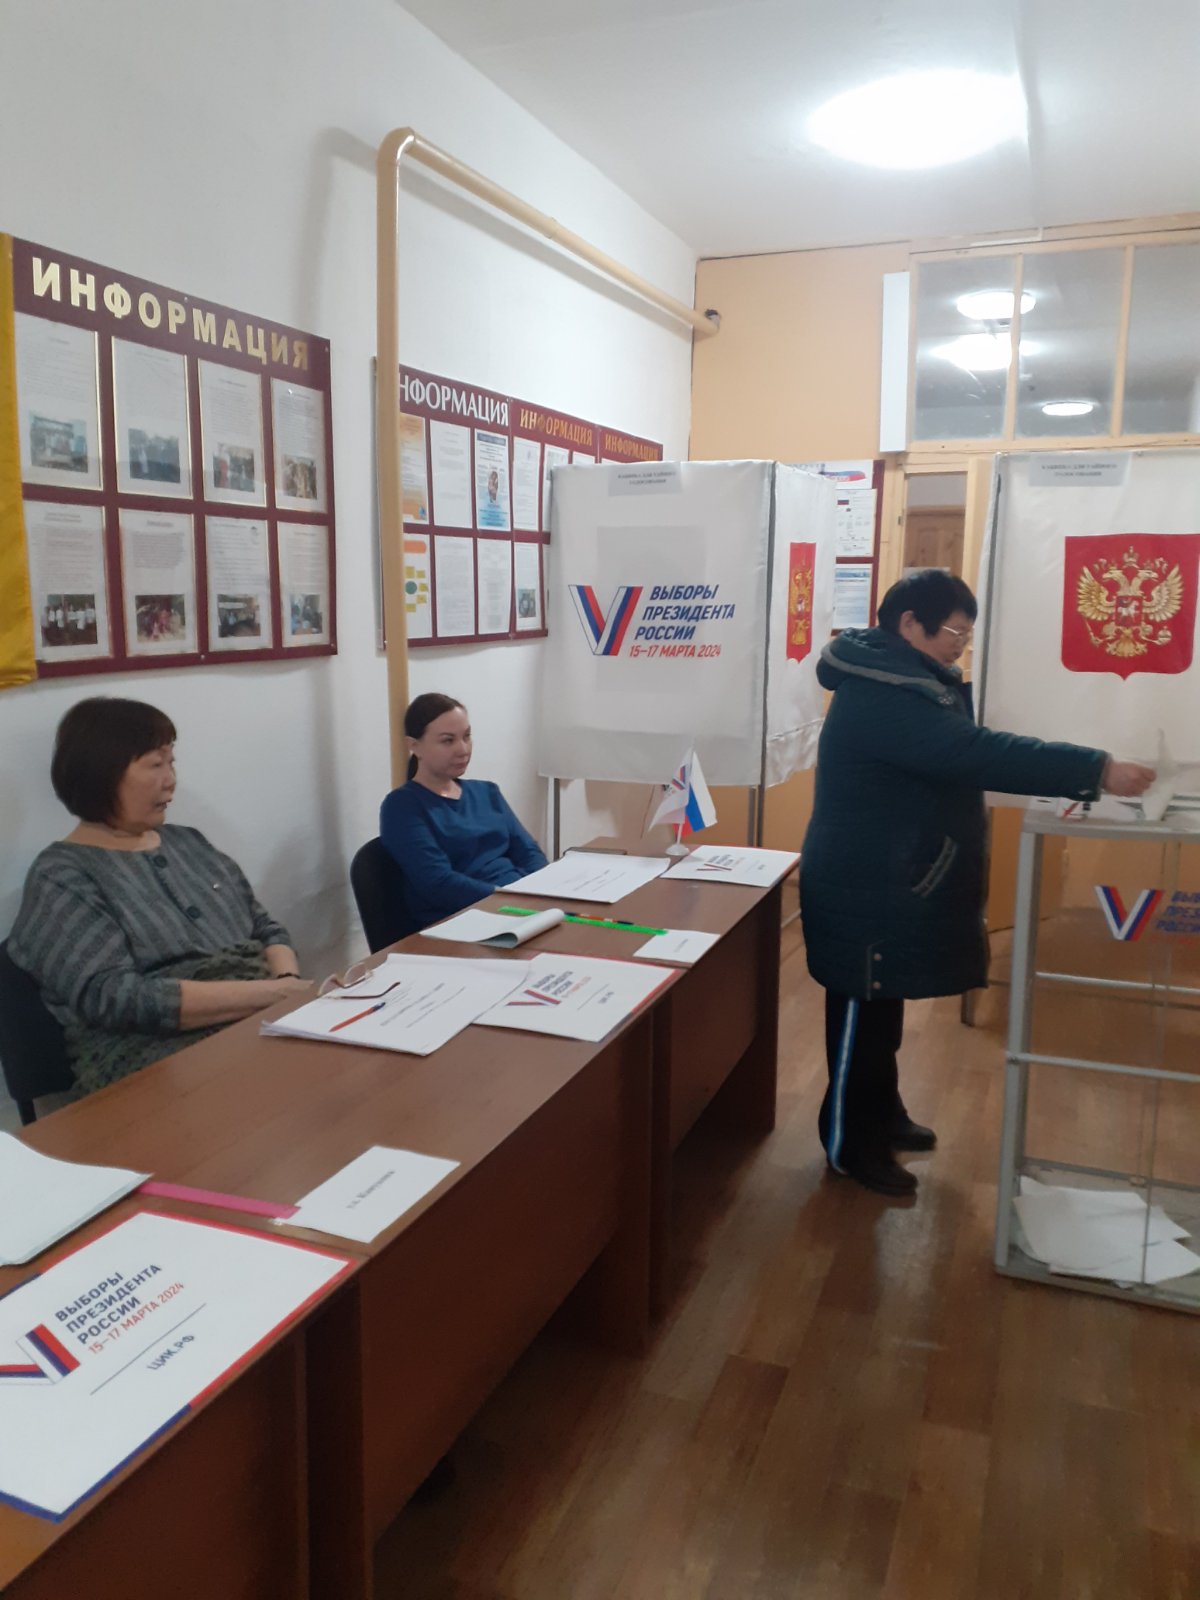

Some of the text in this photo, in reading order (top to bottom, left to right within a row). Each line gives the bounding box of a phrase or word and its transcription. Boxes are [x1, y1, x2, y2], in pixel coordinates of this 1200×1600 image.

[31, 257, 309, 371] ИНФОРМАЦИЯ
[399, 374, 509, 427] НФОРМАЦИЯ
[520, 408, 593, 446] ИНФОРМАЦИЯ
[642, 604, 736, 622] ПРЕЗИДЕНТА
[650, 584, 719, 601] ВЫБОРЫ
[634, 625, 697, 641] РОССИИ
[659, 644, 697, 658] МАРТА
[697, 643, 722, 658] 2024
[55, 1271, 124, 1322] ВЫБОРЫ
[65, 1264, 162, 1333] ПРЕЗИДЕНТА
[120, 1301, 160, 1331] МАРТА
[158, 1281, 185, 1304] 2024
[77, 1296, 141, 1345] РОССИИ
[147, 1335, 195, 1371] ЦИК.РФ
